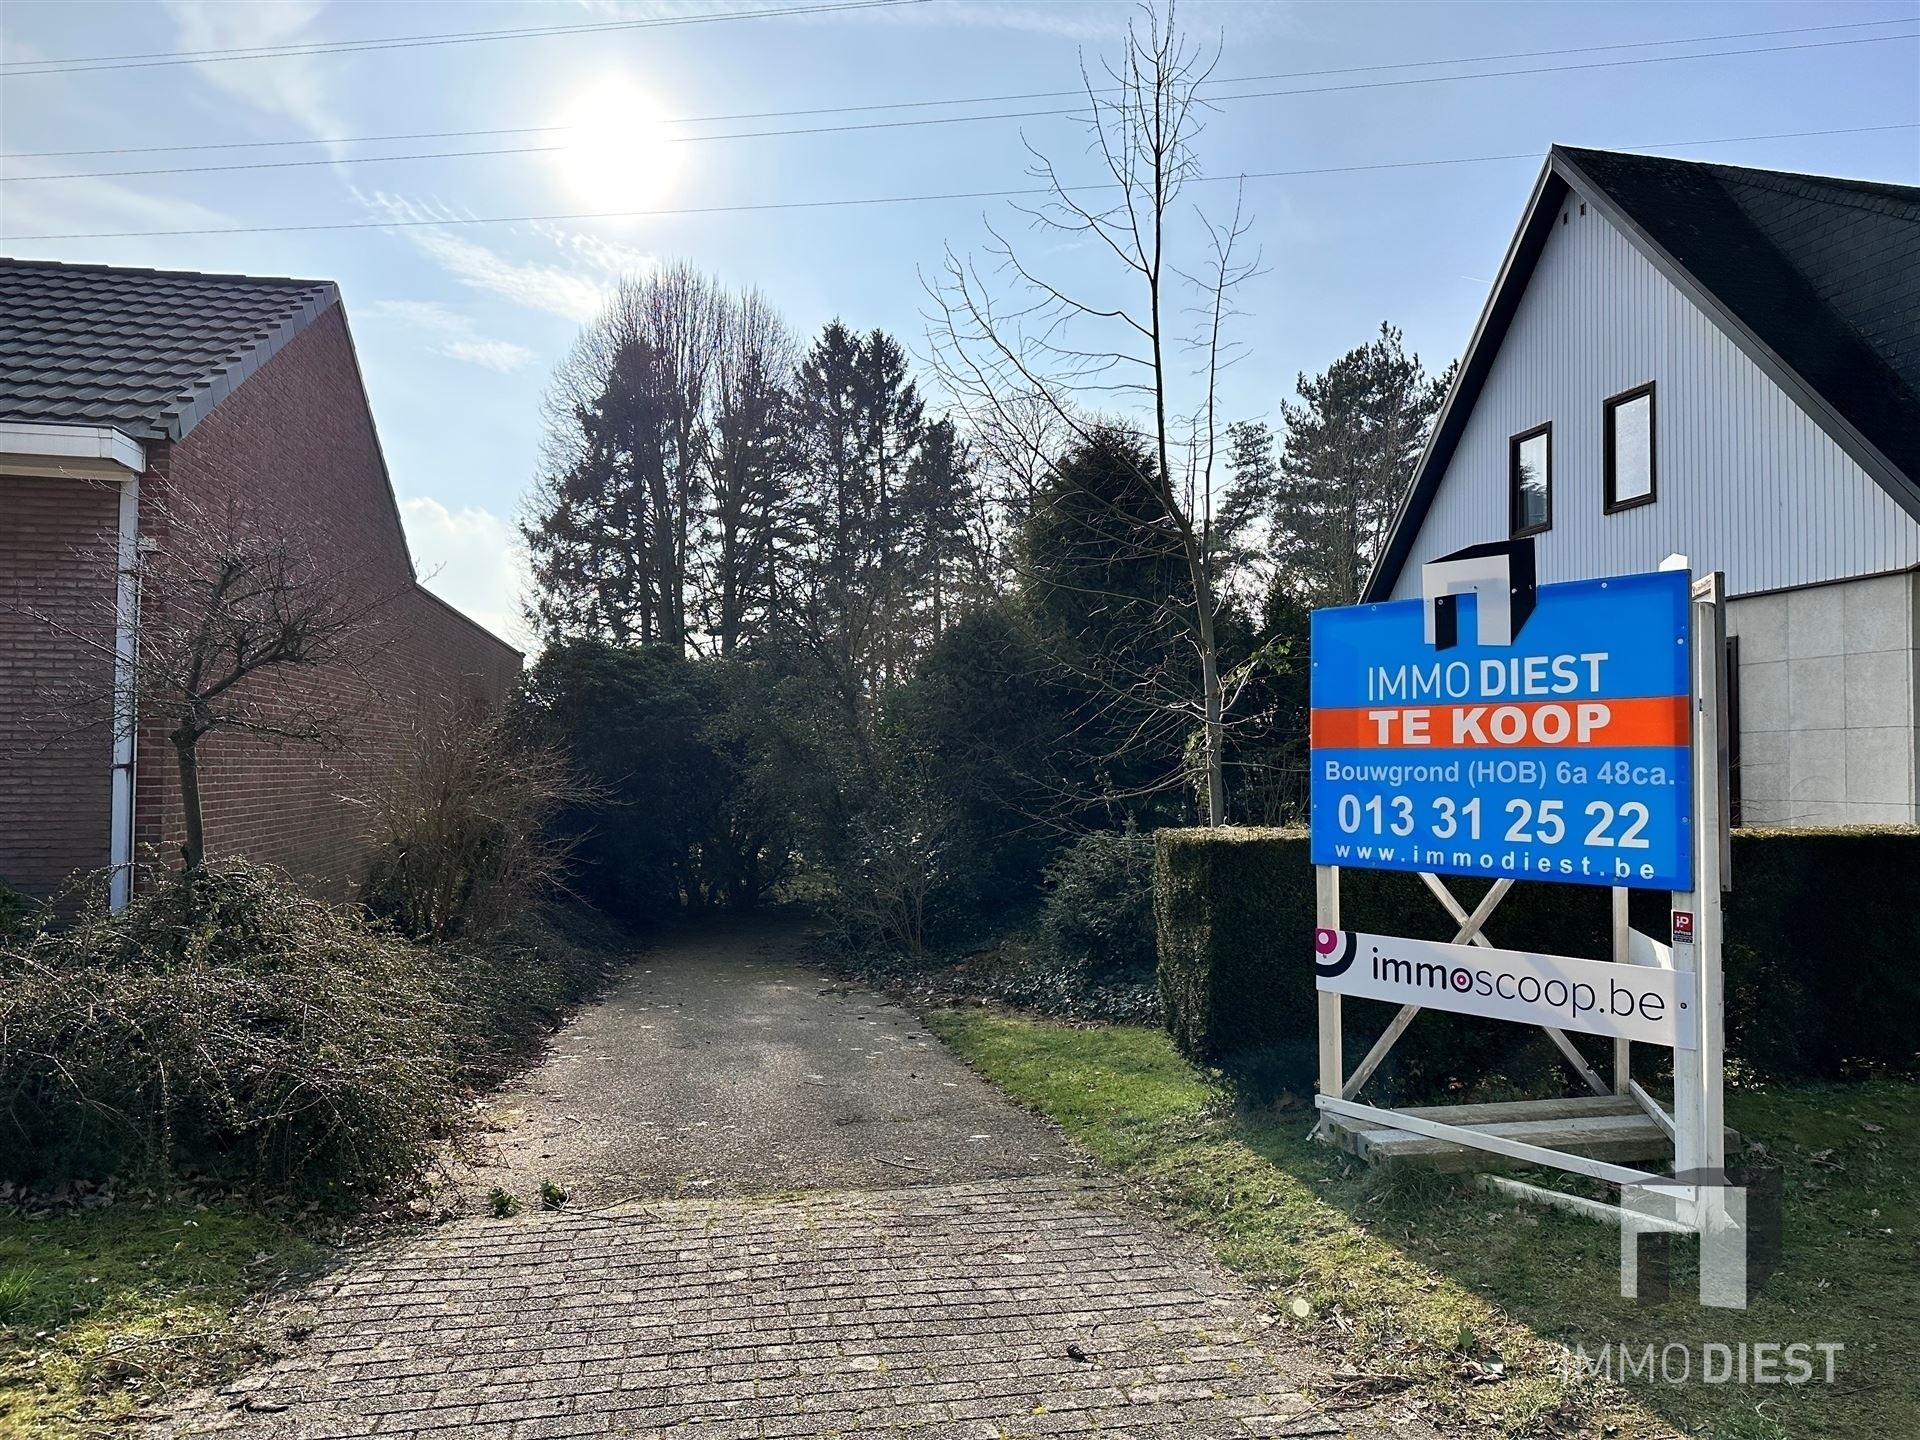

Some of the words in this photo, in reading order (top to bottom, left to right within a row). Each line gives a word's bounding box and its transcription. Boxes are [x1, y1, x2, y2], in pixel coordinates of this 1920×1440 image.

[1369, 661, 1470, 701] IMMO
[1480, 652, 1609, 697] DIEST
[1368, 709, 1432, 745] TE
[1452, 703, 1612, 745] KOOP
[1325, 760, 1460, 786] Bouwgrond
[1468, 760, 1547, 789] (HOB)
[1556, 761, 1588, 785] 6a
[1597, 761, 1676, 786] 48ca.
[1338, 794, 1415, 838] 013
[1431, 797, 1481, 840] 31
[1504, 798, 1566, 845] 25
[1584, 801, 1650, 849] 22
[1335, 845, 1656, 879] www.immodiest.be
[1372, 946, 1666, 1021] immoscoop.be
